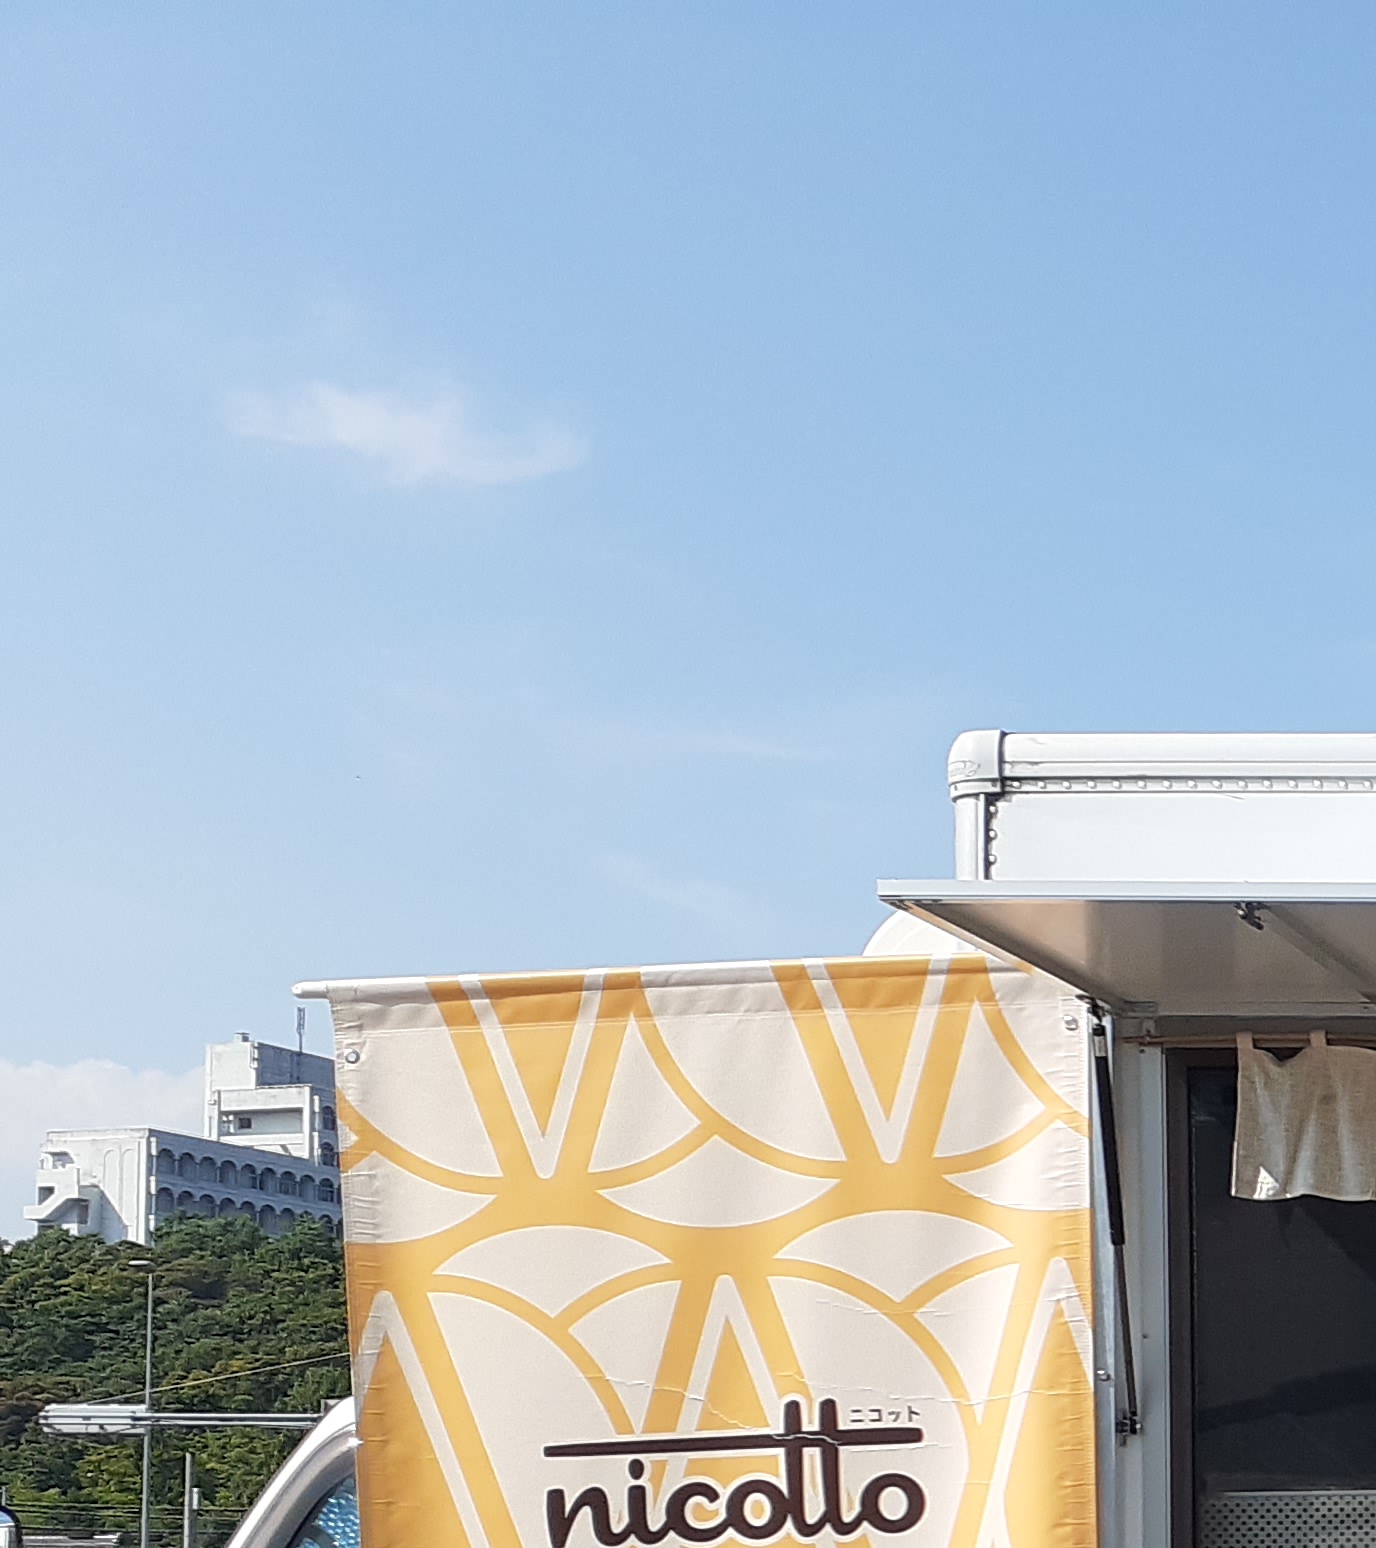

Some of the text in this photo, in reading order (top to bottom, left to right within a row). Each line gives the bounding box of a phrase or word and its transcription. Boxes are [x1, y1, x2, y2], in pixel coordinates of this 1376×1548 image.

[848, 1406, 922, 1424] ニコット
[543, 1398, 926, 1548] nicotto
